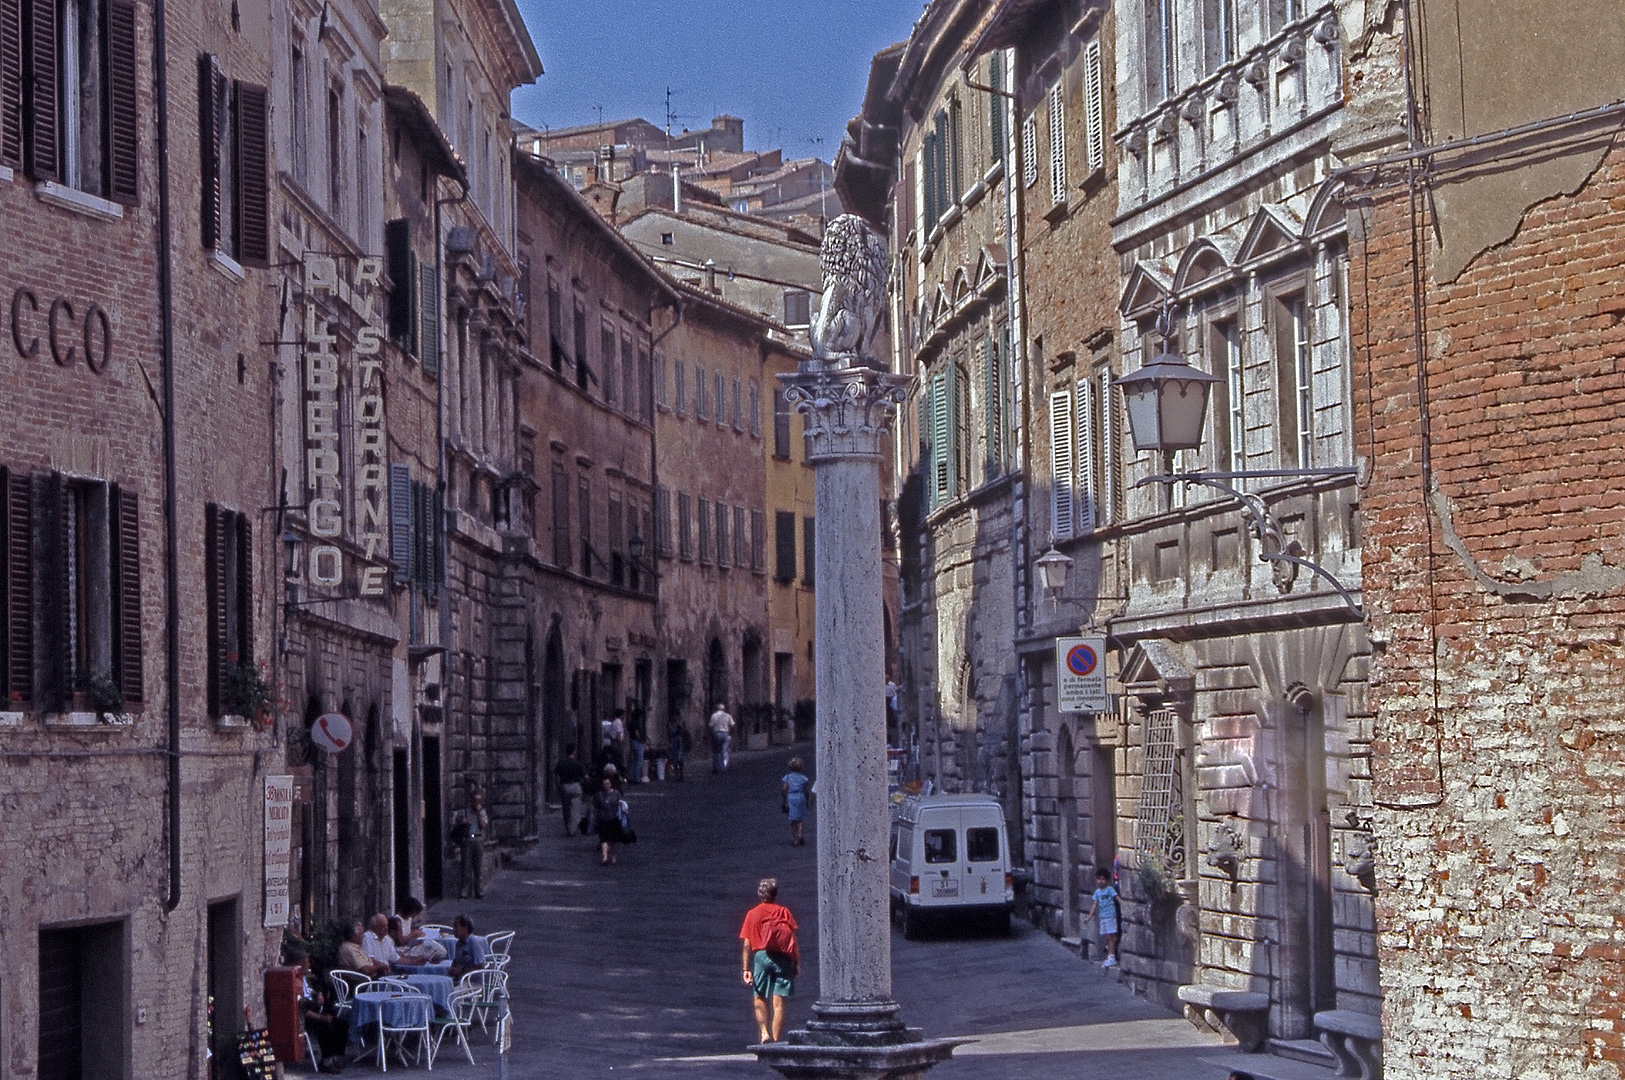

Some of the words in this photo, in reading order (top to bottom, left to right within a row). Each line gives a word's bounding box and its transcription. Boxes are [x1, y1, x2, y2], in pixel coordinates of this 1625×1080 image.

[0, 286, 111, 376] CCO
[305, 257, 342, 587] ALBERGO
[354, 258, 388, 595] RISTORANTE
